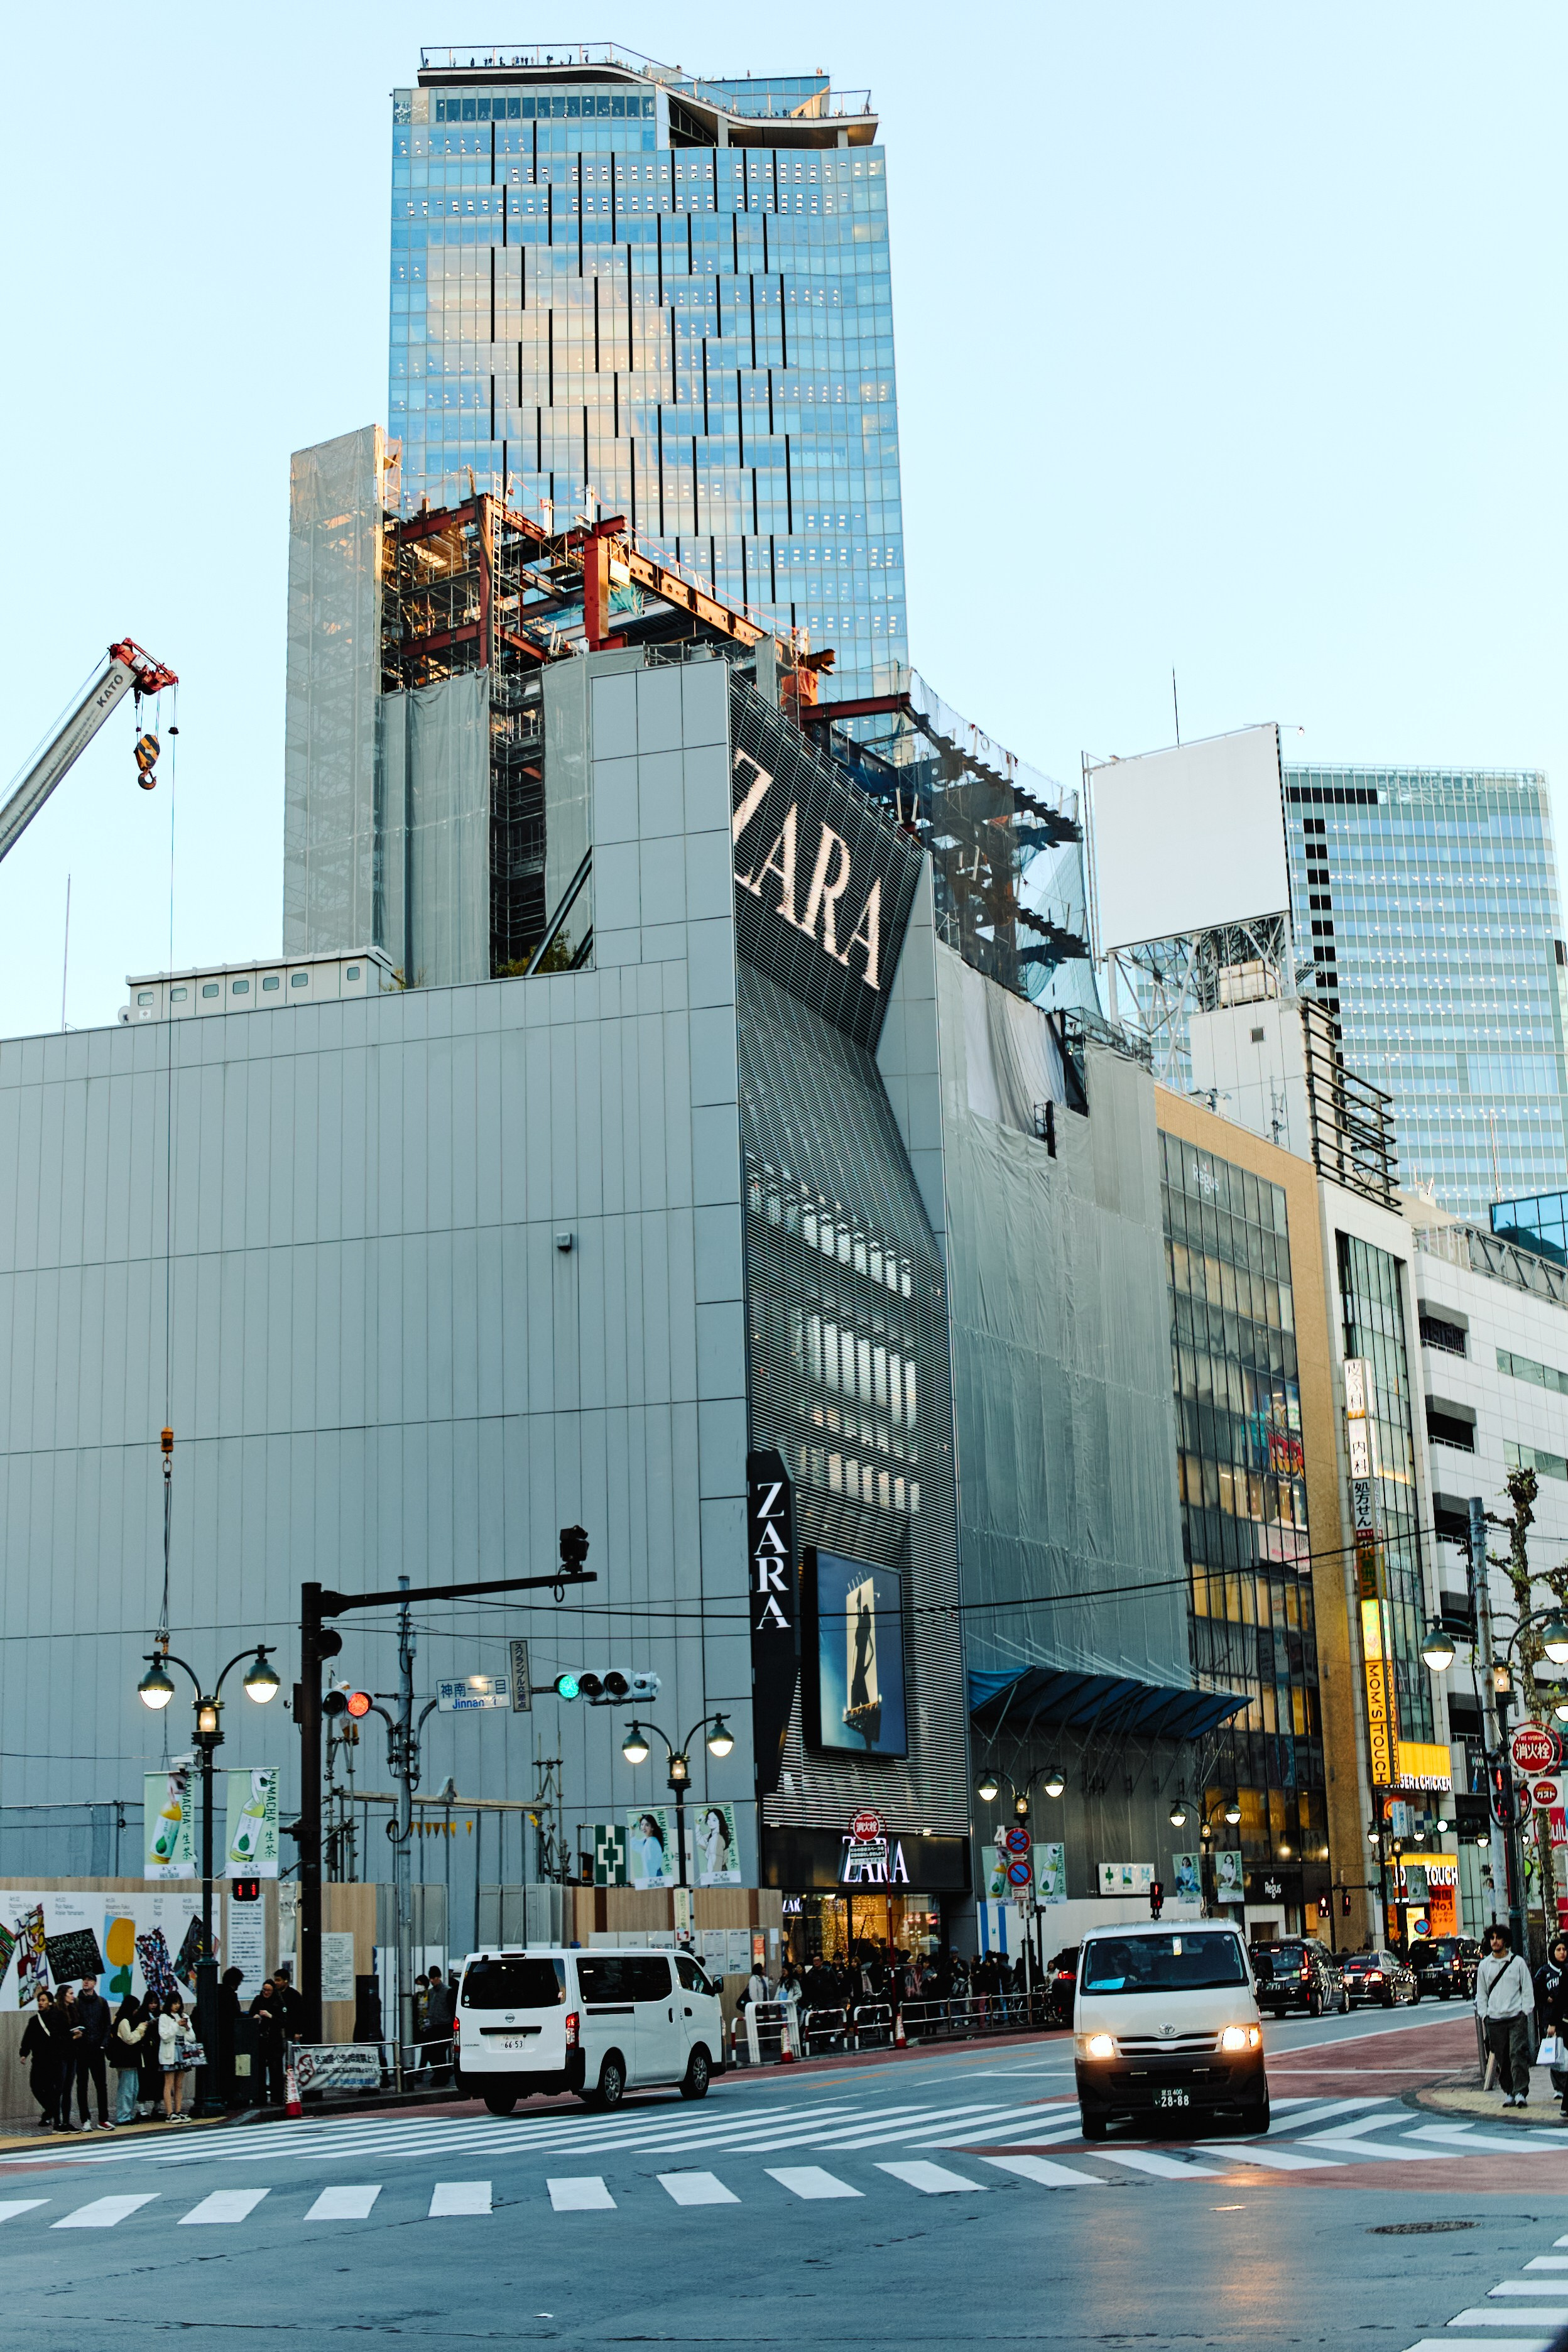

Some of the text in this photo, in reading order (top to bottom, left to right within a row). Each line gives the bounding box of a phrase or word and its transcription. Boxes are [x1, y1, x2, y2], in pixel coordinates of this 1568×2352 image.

[96, 674, 124, 708] KATO
[732, 748, 881, 991] ZARA
[1192, 1163, 1219, 1195] Regus
[1348, 1361, 1362, 1408] 皮ふ科
[1353, 1441, 1368, 1473] 内科
[1354, 1482, 1371, 1528] 処方せん
[754, 1481, 792, 1630] ZARA
[514, 1643, 527, 1709] スクランブル交差点
[440, 1679, 506, 1699] 神南一丁目
[452, 1697, 484, 1710] Jinnan
[1368, 1665, 1386, 1783] MOM'S TOUCH
[1515, 1742, 1550, 1760] 消火栓
[1537, 1791, 1555, 1799] ガスト
[856, 1821, 878, 1833] 消火栓
[182, 1832, 193, 1860] 生茶
[264, 1831, 276, 1858] 生茶
[663, 1853, 673, 1873] 生茶
[729, 1848, 739, 1869] 生茶
[1424, 1865, 1459, 1886] TOUCH
[1265, 1881, 1282, 1899] Regus
[1432, 1901, 1453, 1911] No.1
[504, 2040, 523, 2049] 66-53
[1161, 2094, 1189, 2108] 28-88
